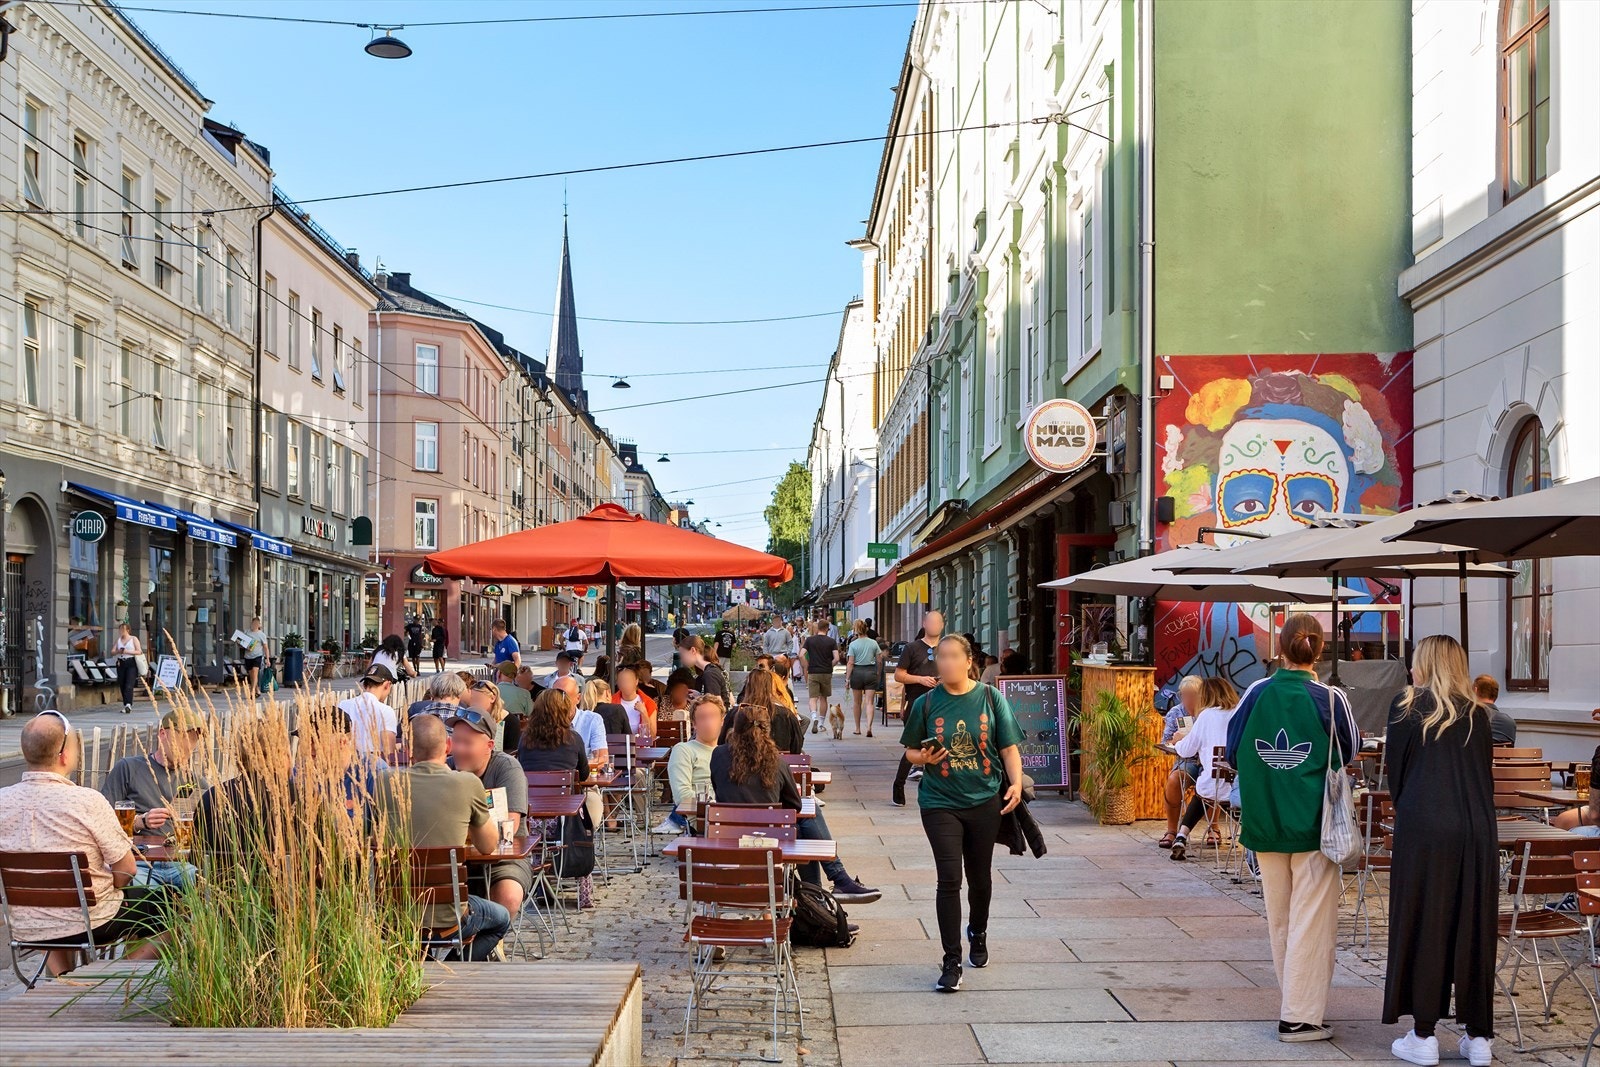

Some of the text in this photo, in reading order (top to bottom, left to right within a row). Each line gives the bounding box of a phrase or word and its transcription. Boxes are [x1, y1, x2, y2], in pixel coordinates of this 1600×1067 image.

[1036, 424, 1086, 436] MUCHO
[1036, 436, 1086, 448] MAS
[76, 519, 102, 534] CHAIR
